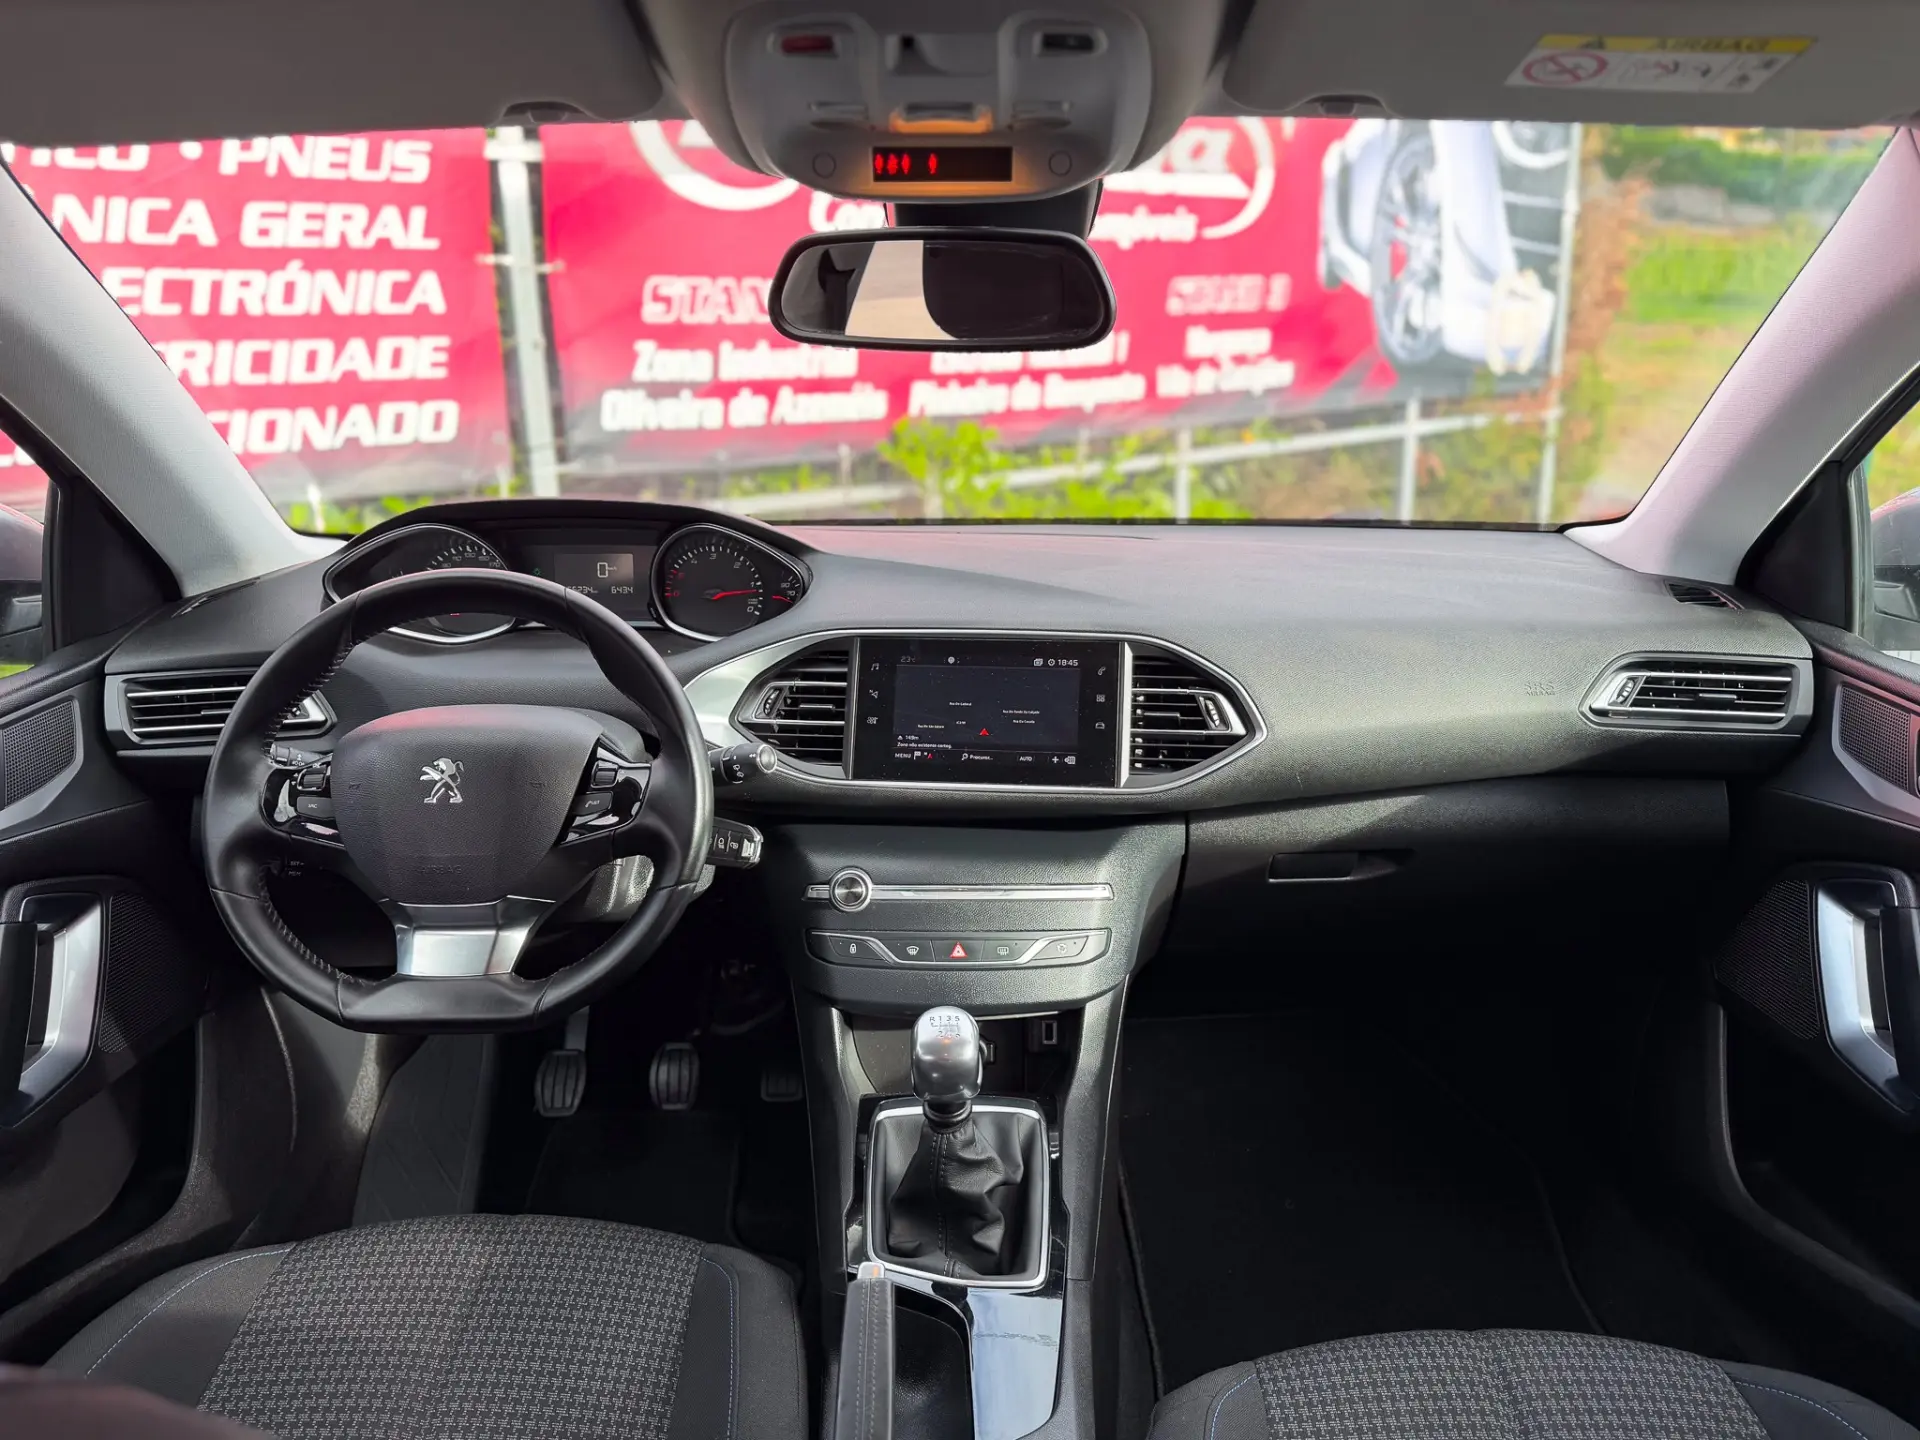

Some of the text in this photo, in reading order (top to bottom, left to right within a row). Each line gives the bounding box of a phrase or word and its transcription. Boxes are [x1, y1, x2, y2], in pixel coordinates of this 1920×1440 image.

[219, 135, 432, 183] PNEUS
[50, 193, 440, 250] NICA GERAL
[102, 260, 447, 316] ECTRÓNICA
[641, 275, 770, 325] STAN
[205, 400, 460, 455] IONADO
[1057, 659, 1079, 667] 18:45
